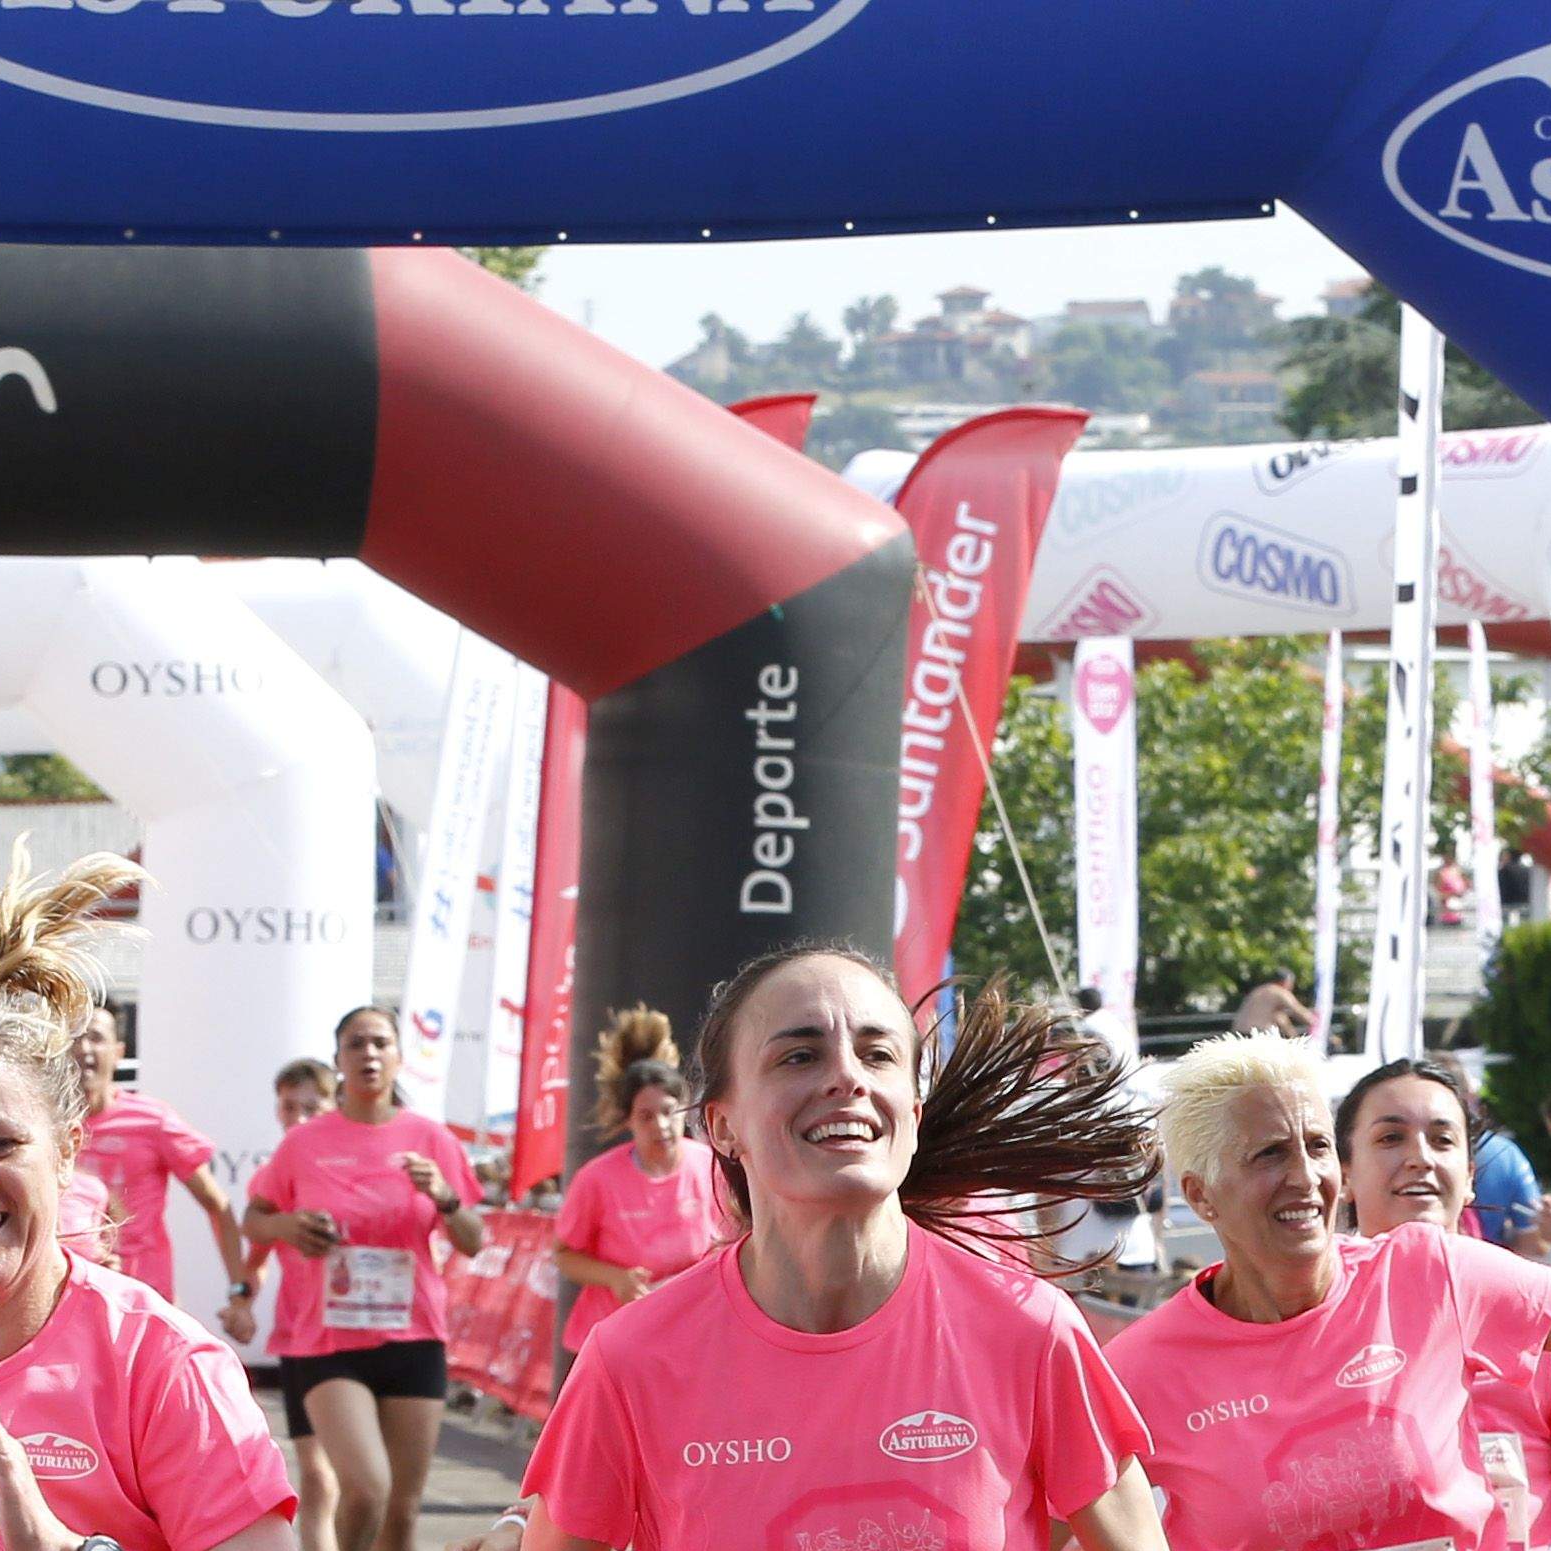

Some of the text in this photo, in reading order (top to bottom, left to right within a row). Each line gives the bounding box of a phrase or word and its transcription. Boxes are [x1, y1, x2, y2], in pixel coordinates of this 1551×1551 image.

[1212, 525, 1340, 608] COSMO
[91, 660, 263, 698] OYSHO
[741, 662, 809, 915] Deporte
[186, 907, 347, 943] OYSHO
[1187, 1394, 1269, 1432] OYSHO
[683, 1437, 793, 1467] OYSHO
[888, 1431, 971, 1451] ASTURIANA
